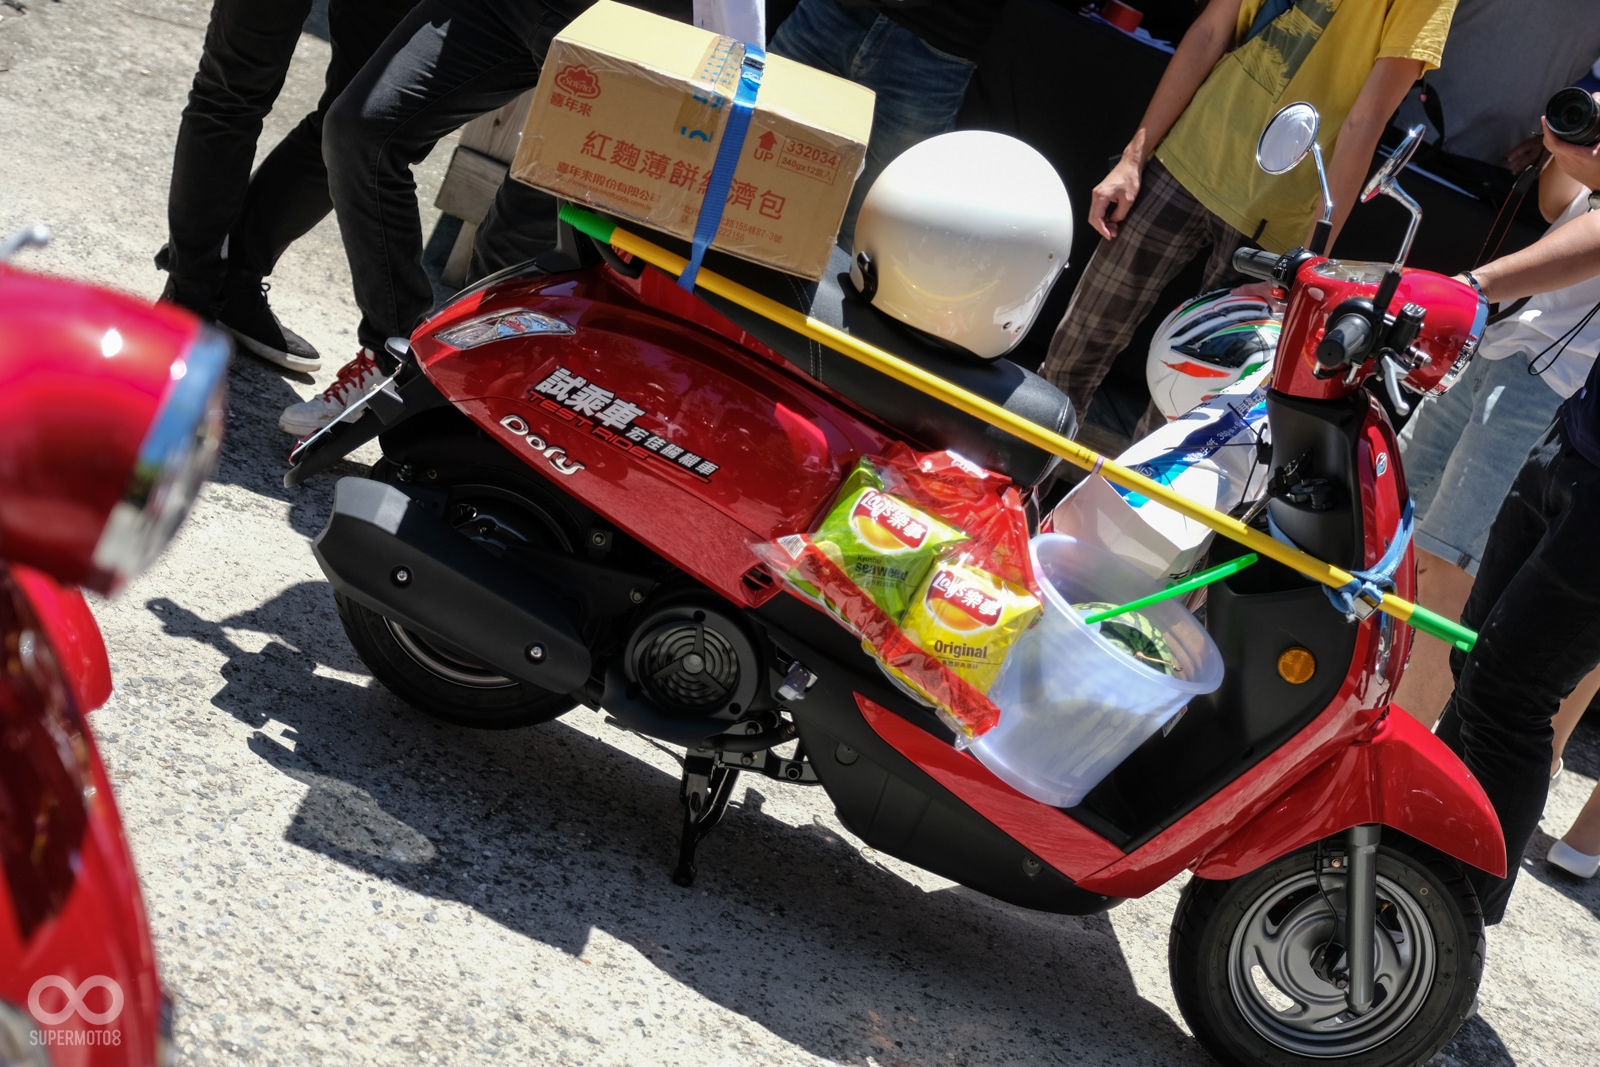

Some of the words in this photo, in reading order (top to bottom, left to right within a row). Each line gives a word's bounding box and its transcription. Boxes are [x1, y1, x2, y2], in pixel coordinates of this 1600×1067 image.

[753, 147, 774, 162] UP
[786, 140, 838, 167] 332034
[534, 367, 647, 430] 試乘車
[500, 414, 585, 475] Dory
[527, 390, 594, 428] TEST
[591, 425, 651, 460] RIDE
[624, 425, 720, 476] 宏佳騰機車
[855, 562, 909, 581] seaweed
[934, 640, 988, 659] Original
